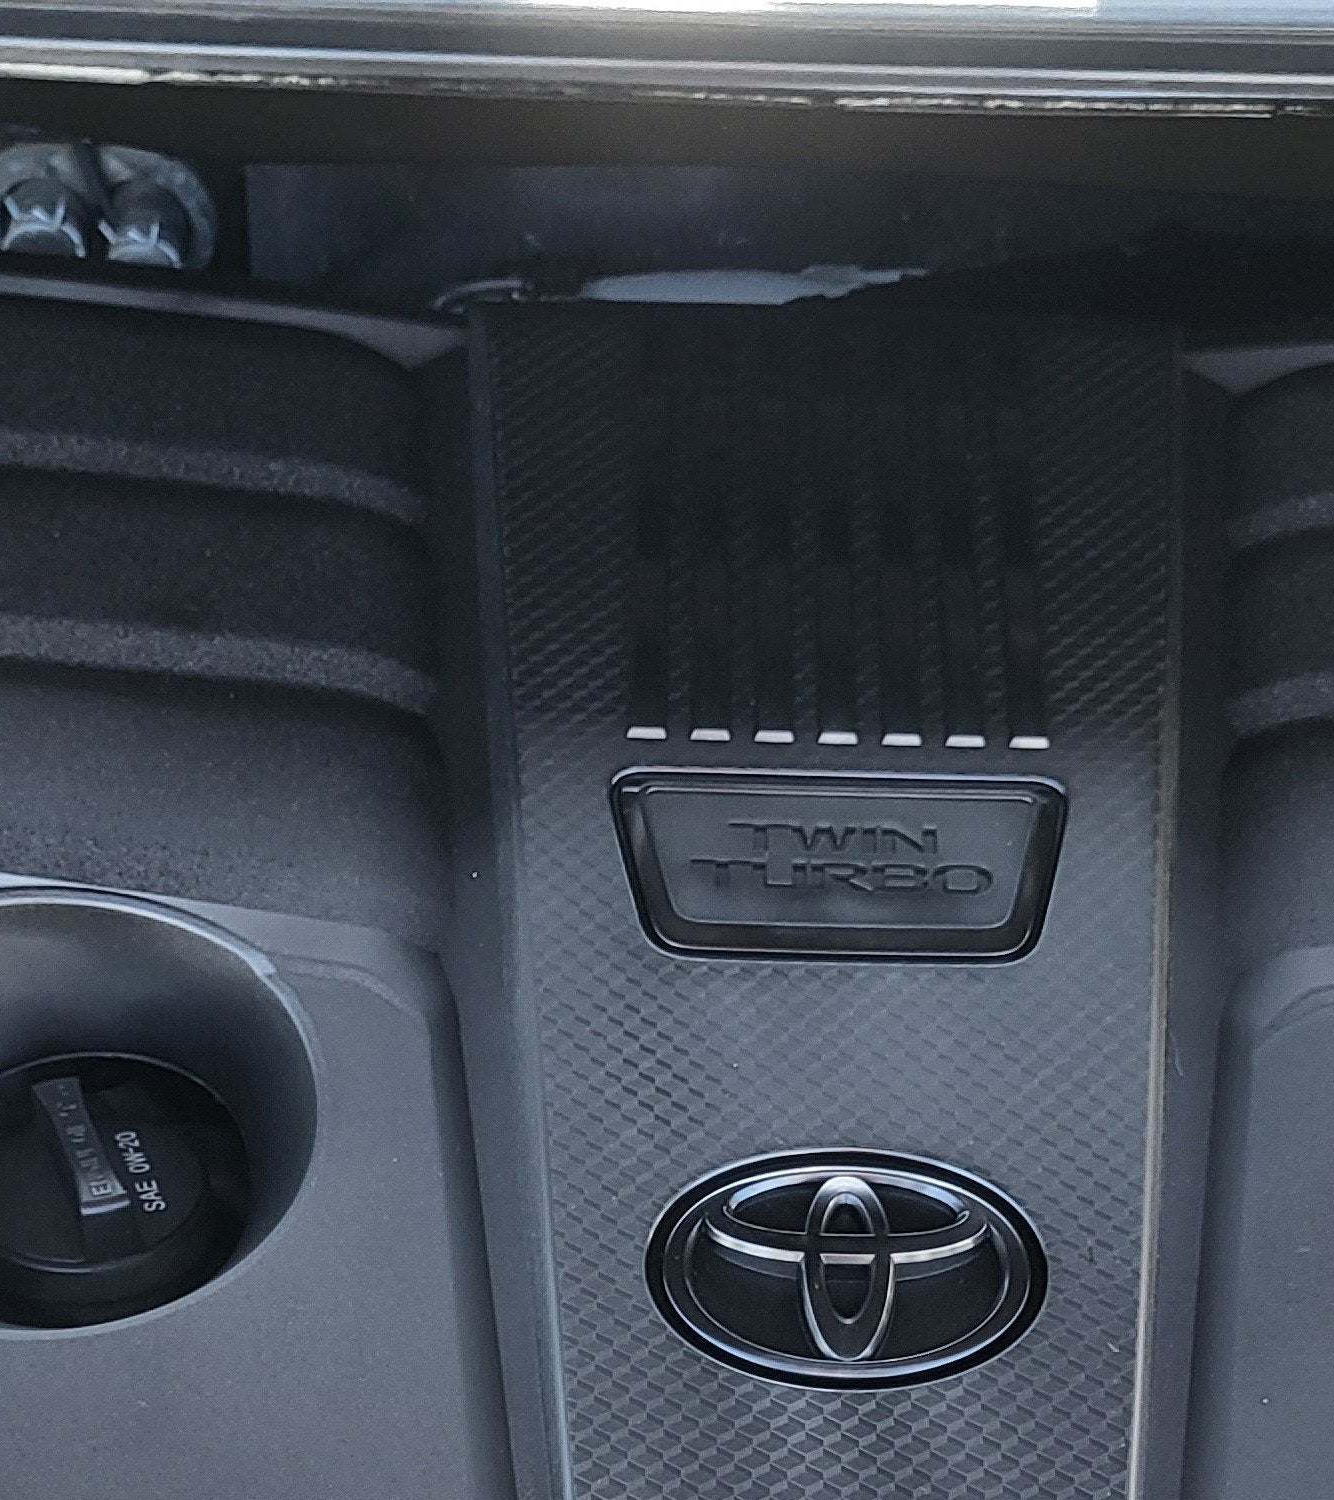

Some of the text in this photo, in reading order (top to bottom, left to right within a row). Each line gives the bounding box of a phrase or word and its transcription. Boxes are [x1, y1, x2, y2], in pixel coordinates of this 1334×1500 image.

[728, 820, 938, 853] TWIN
[689, 856, 995, 895] TURBO
[114, 1131, 166, 1212] SAE 0W-20
